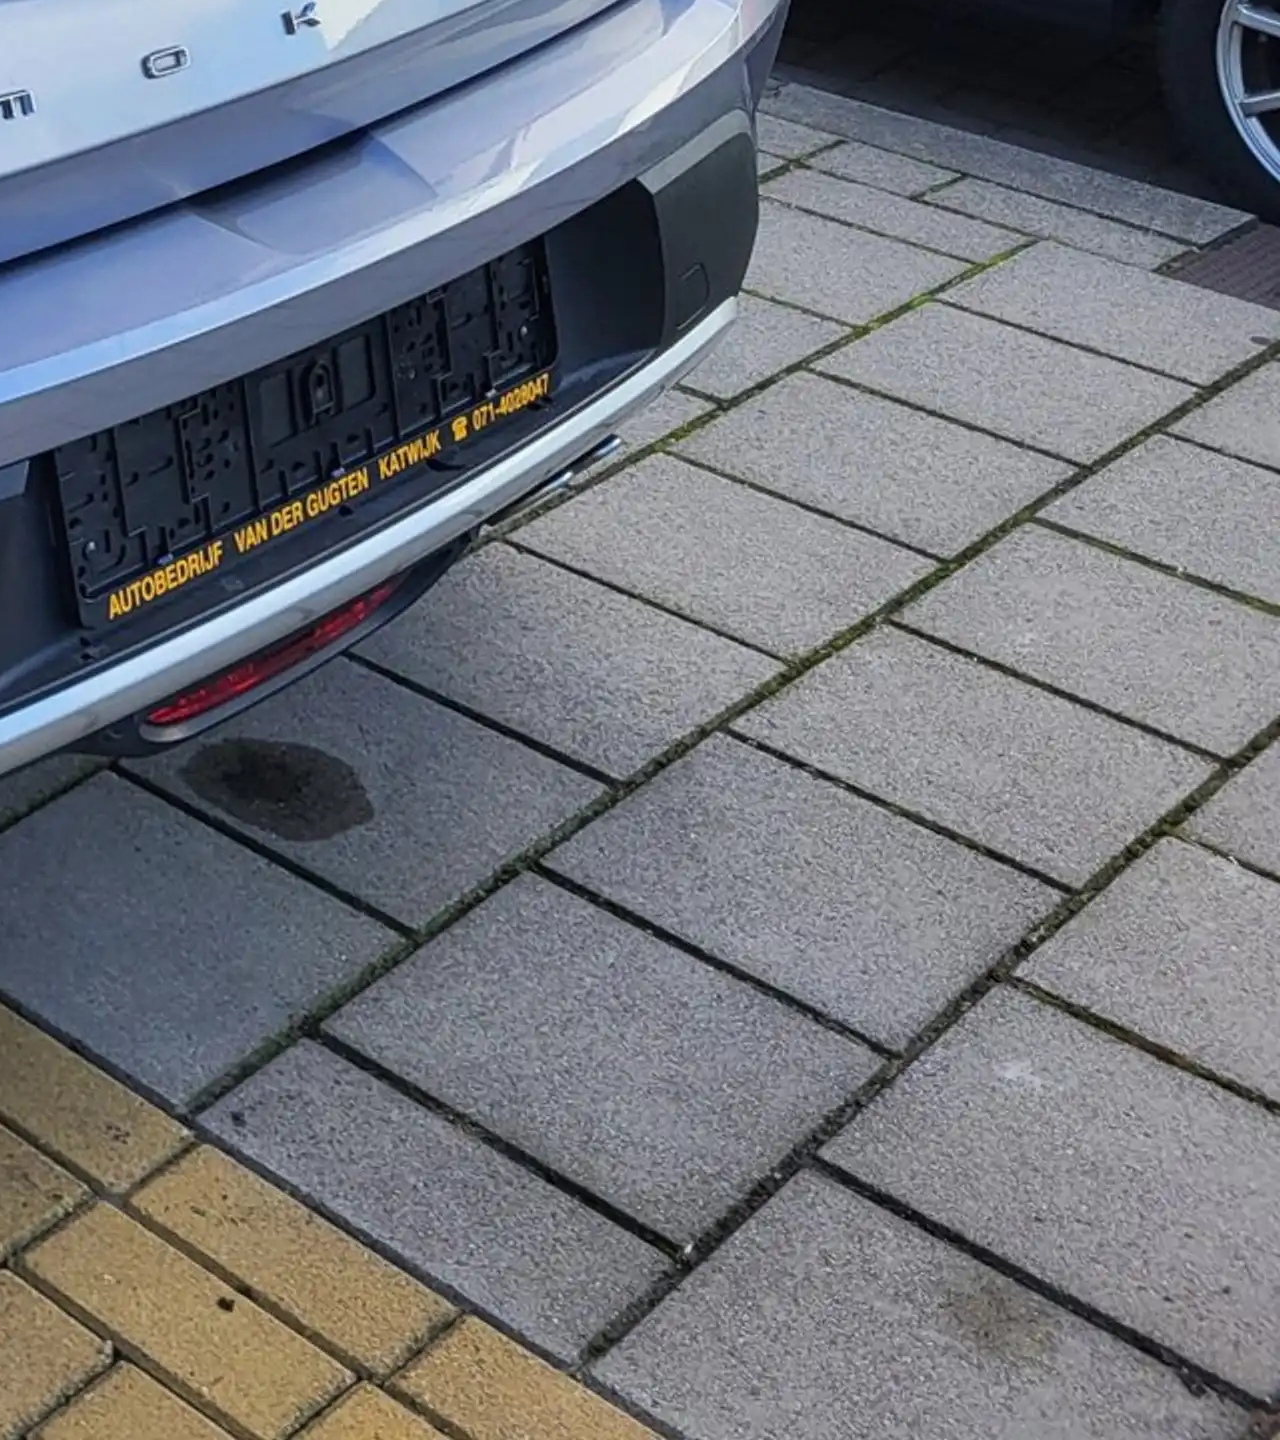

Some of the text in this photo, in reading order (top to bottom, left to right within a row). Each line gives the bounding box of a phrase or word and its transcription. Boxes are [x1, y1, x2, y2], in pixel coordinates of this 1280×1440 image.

[107, 539, 224, 621] AUTOBEDRIJF
[233, 518, 268, 554] VAN
[271, 500, 304, 537] DER
[306, 467, 370, 518] GUGTEN
[378, 429, 442, 481] KATWIJK
